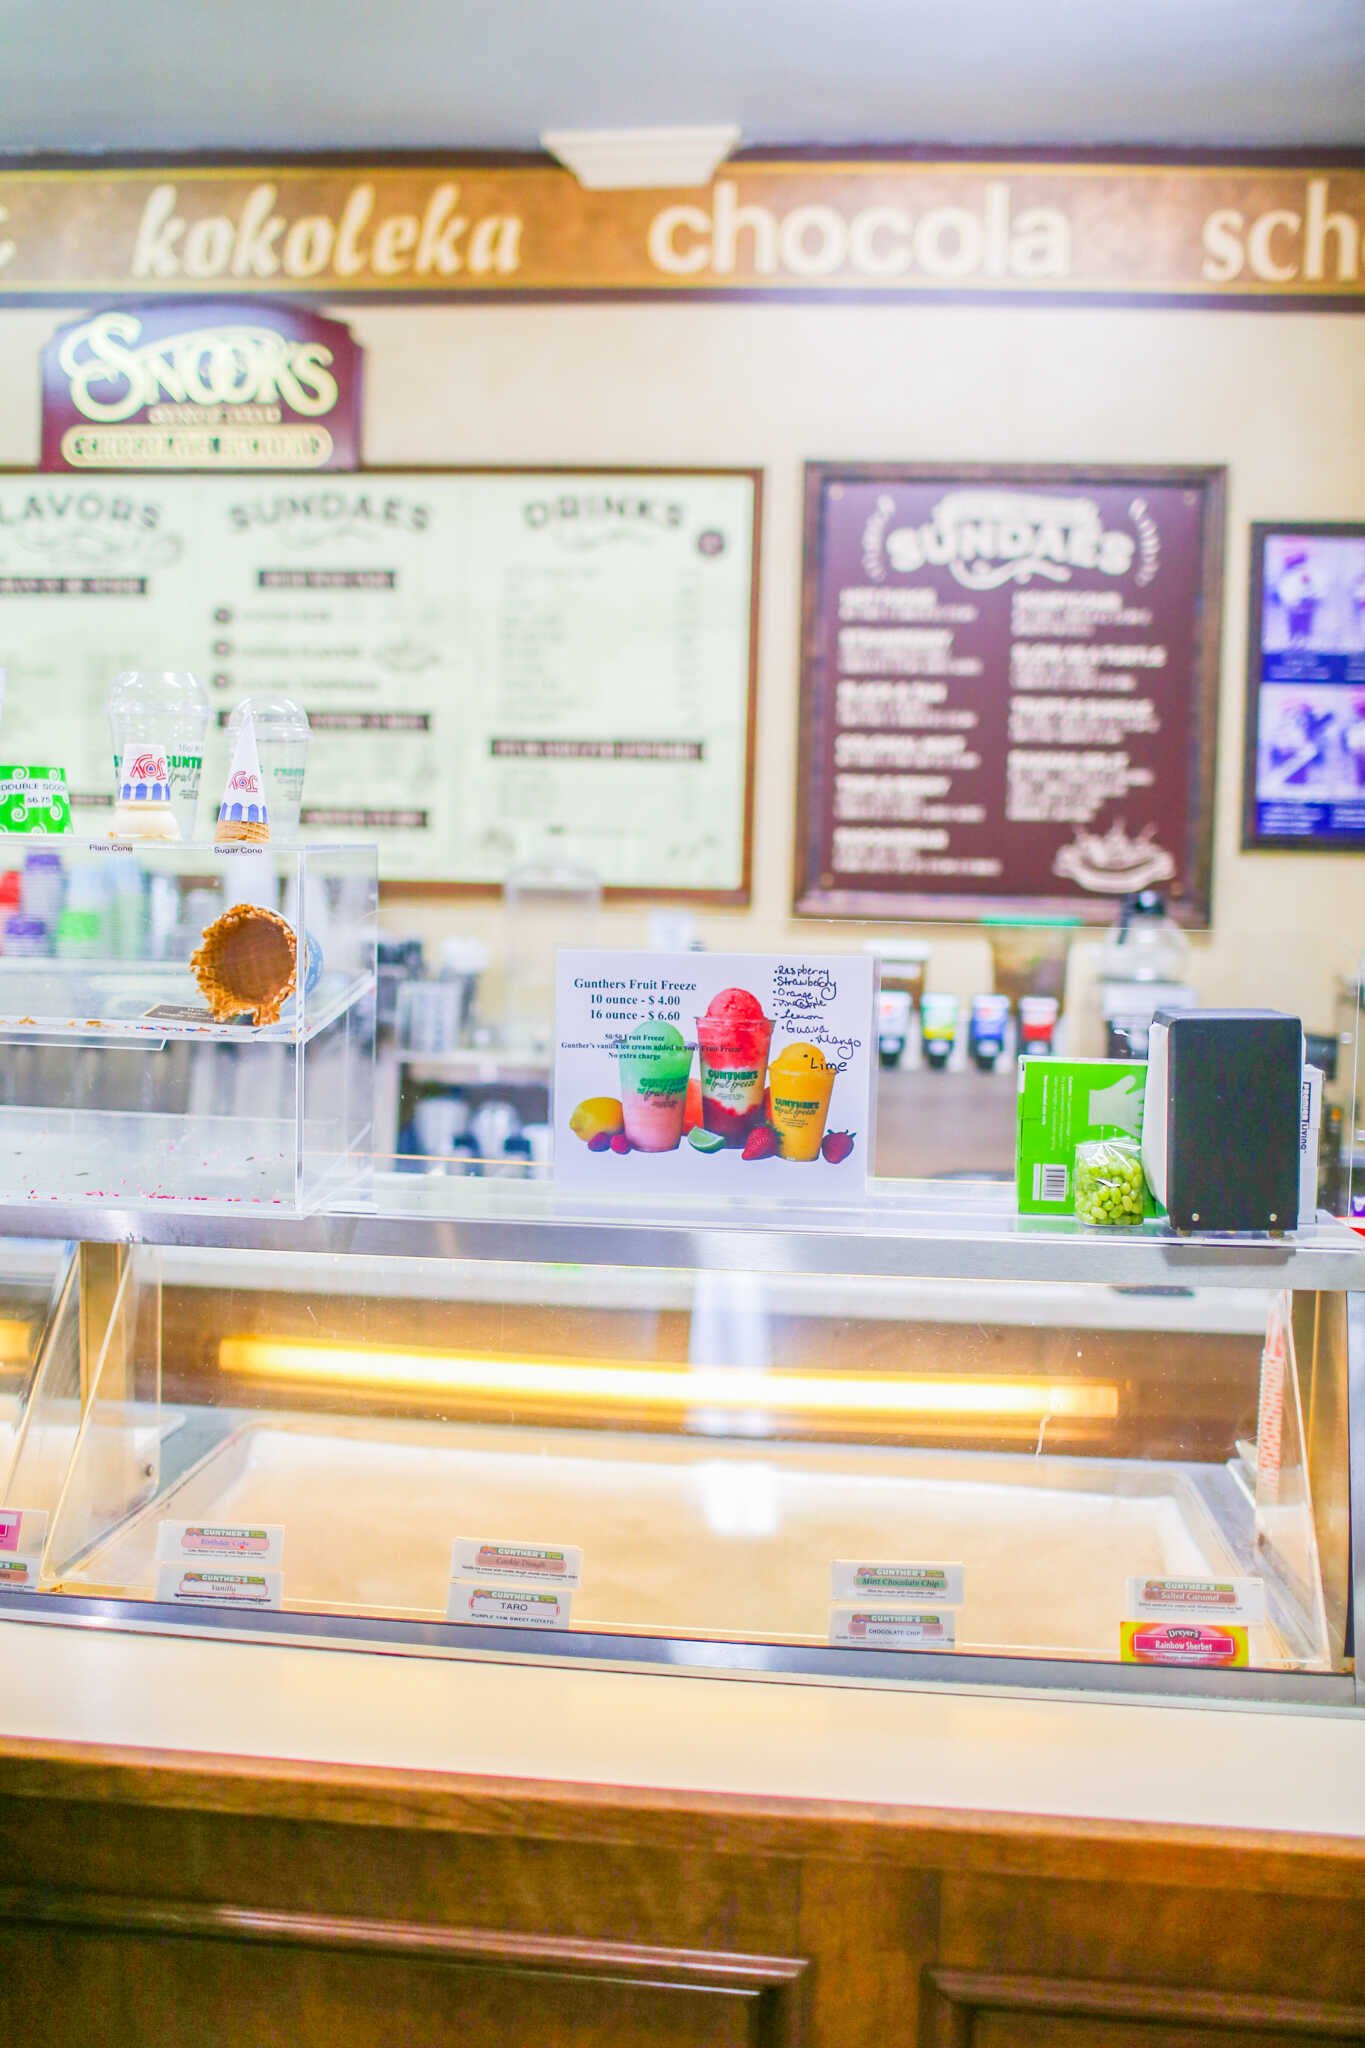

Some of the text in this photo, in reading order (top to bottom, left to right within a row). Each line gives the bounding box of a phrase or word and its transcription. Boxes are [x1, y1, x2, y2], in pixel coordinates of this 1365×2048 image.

[131, 182, 523, 278] kokoleka
[647, 180, 1072, 275] chocola
[1202, 178, 1365, 282] sch
[228, 493, 430, 532] SUNDAES
[524, 494, 684, 531] DRINKS
[886, 519, 1136, 576] SUNDAES
[1, 783, 37, 791] DOUBLE
[89, 844, 133, 852] Plain Cone
[214, 846, 263, 855] Sugar Cone
[574, 978, 697, 991] Gunthers Fruit Freeze
[591, 994, 603, 1004] 10
[605, 996, 638, 1005] ounce
[657, 995, 681, 1005] 4.00
[778, 987, 814, 1000] Orange
[591, 1009, 603, 1019] 16
[605, 1011, 638, 1020] ounce
[657, 1011, 680, 1021] 6.60
[780, 1008, 824, 1020] Lemon
[786, 1020, 829, 1034] Guava
[816, 1034, 862, 1056] Mango
[810, 1057, 848, 1072] Lime
[862, 1577, 880, 1586] Mint
[922, 1579, 940, 1589] Chip
[1161, 1591, 1220, 1602] Salted Caramel
[500, 1601, 528, 1612] TARO
[868, 1627, 921, 1637] CHOCOLATE CHIP
[1155, 1639, 1213, 1651] Rainbow Sherbet
